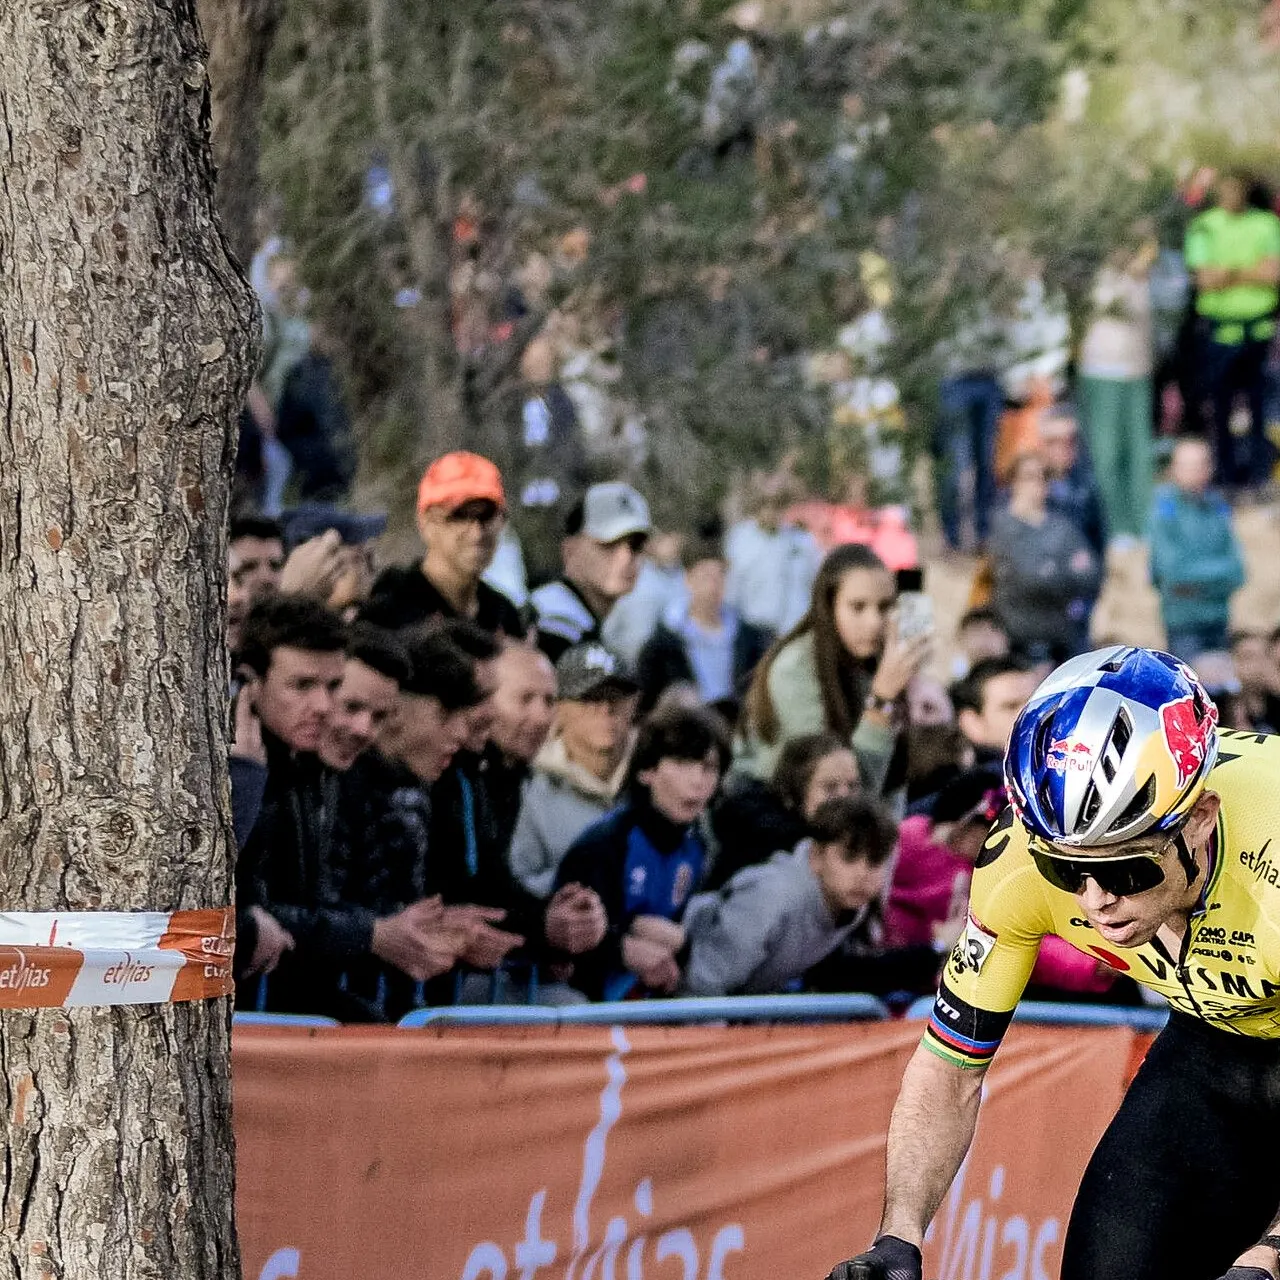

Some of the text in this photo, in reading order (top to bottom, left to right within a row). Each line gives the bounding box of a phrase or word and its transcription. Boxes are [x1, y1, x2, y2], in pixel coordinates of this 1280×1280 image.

[1069, 758, 1093, 772] Bull
[0, 947, 50, 997] ethias
[103, 951, 155, 991] ethias
